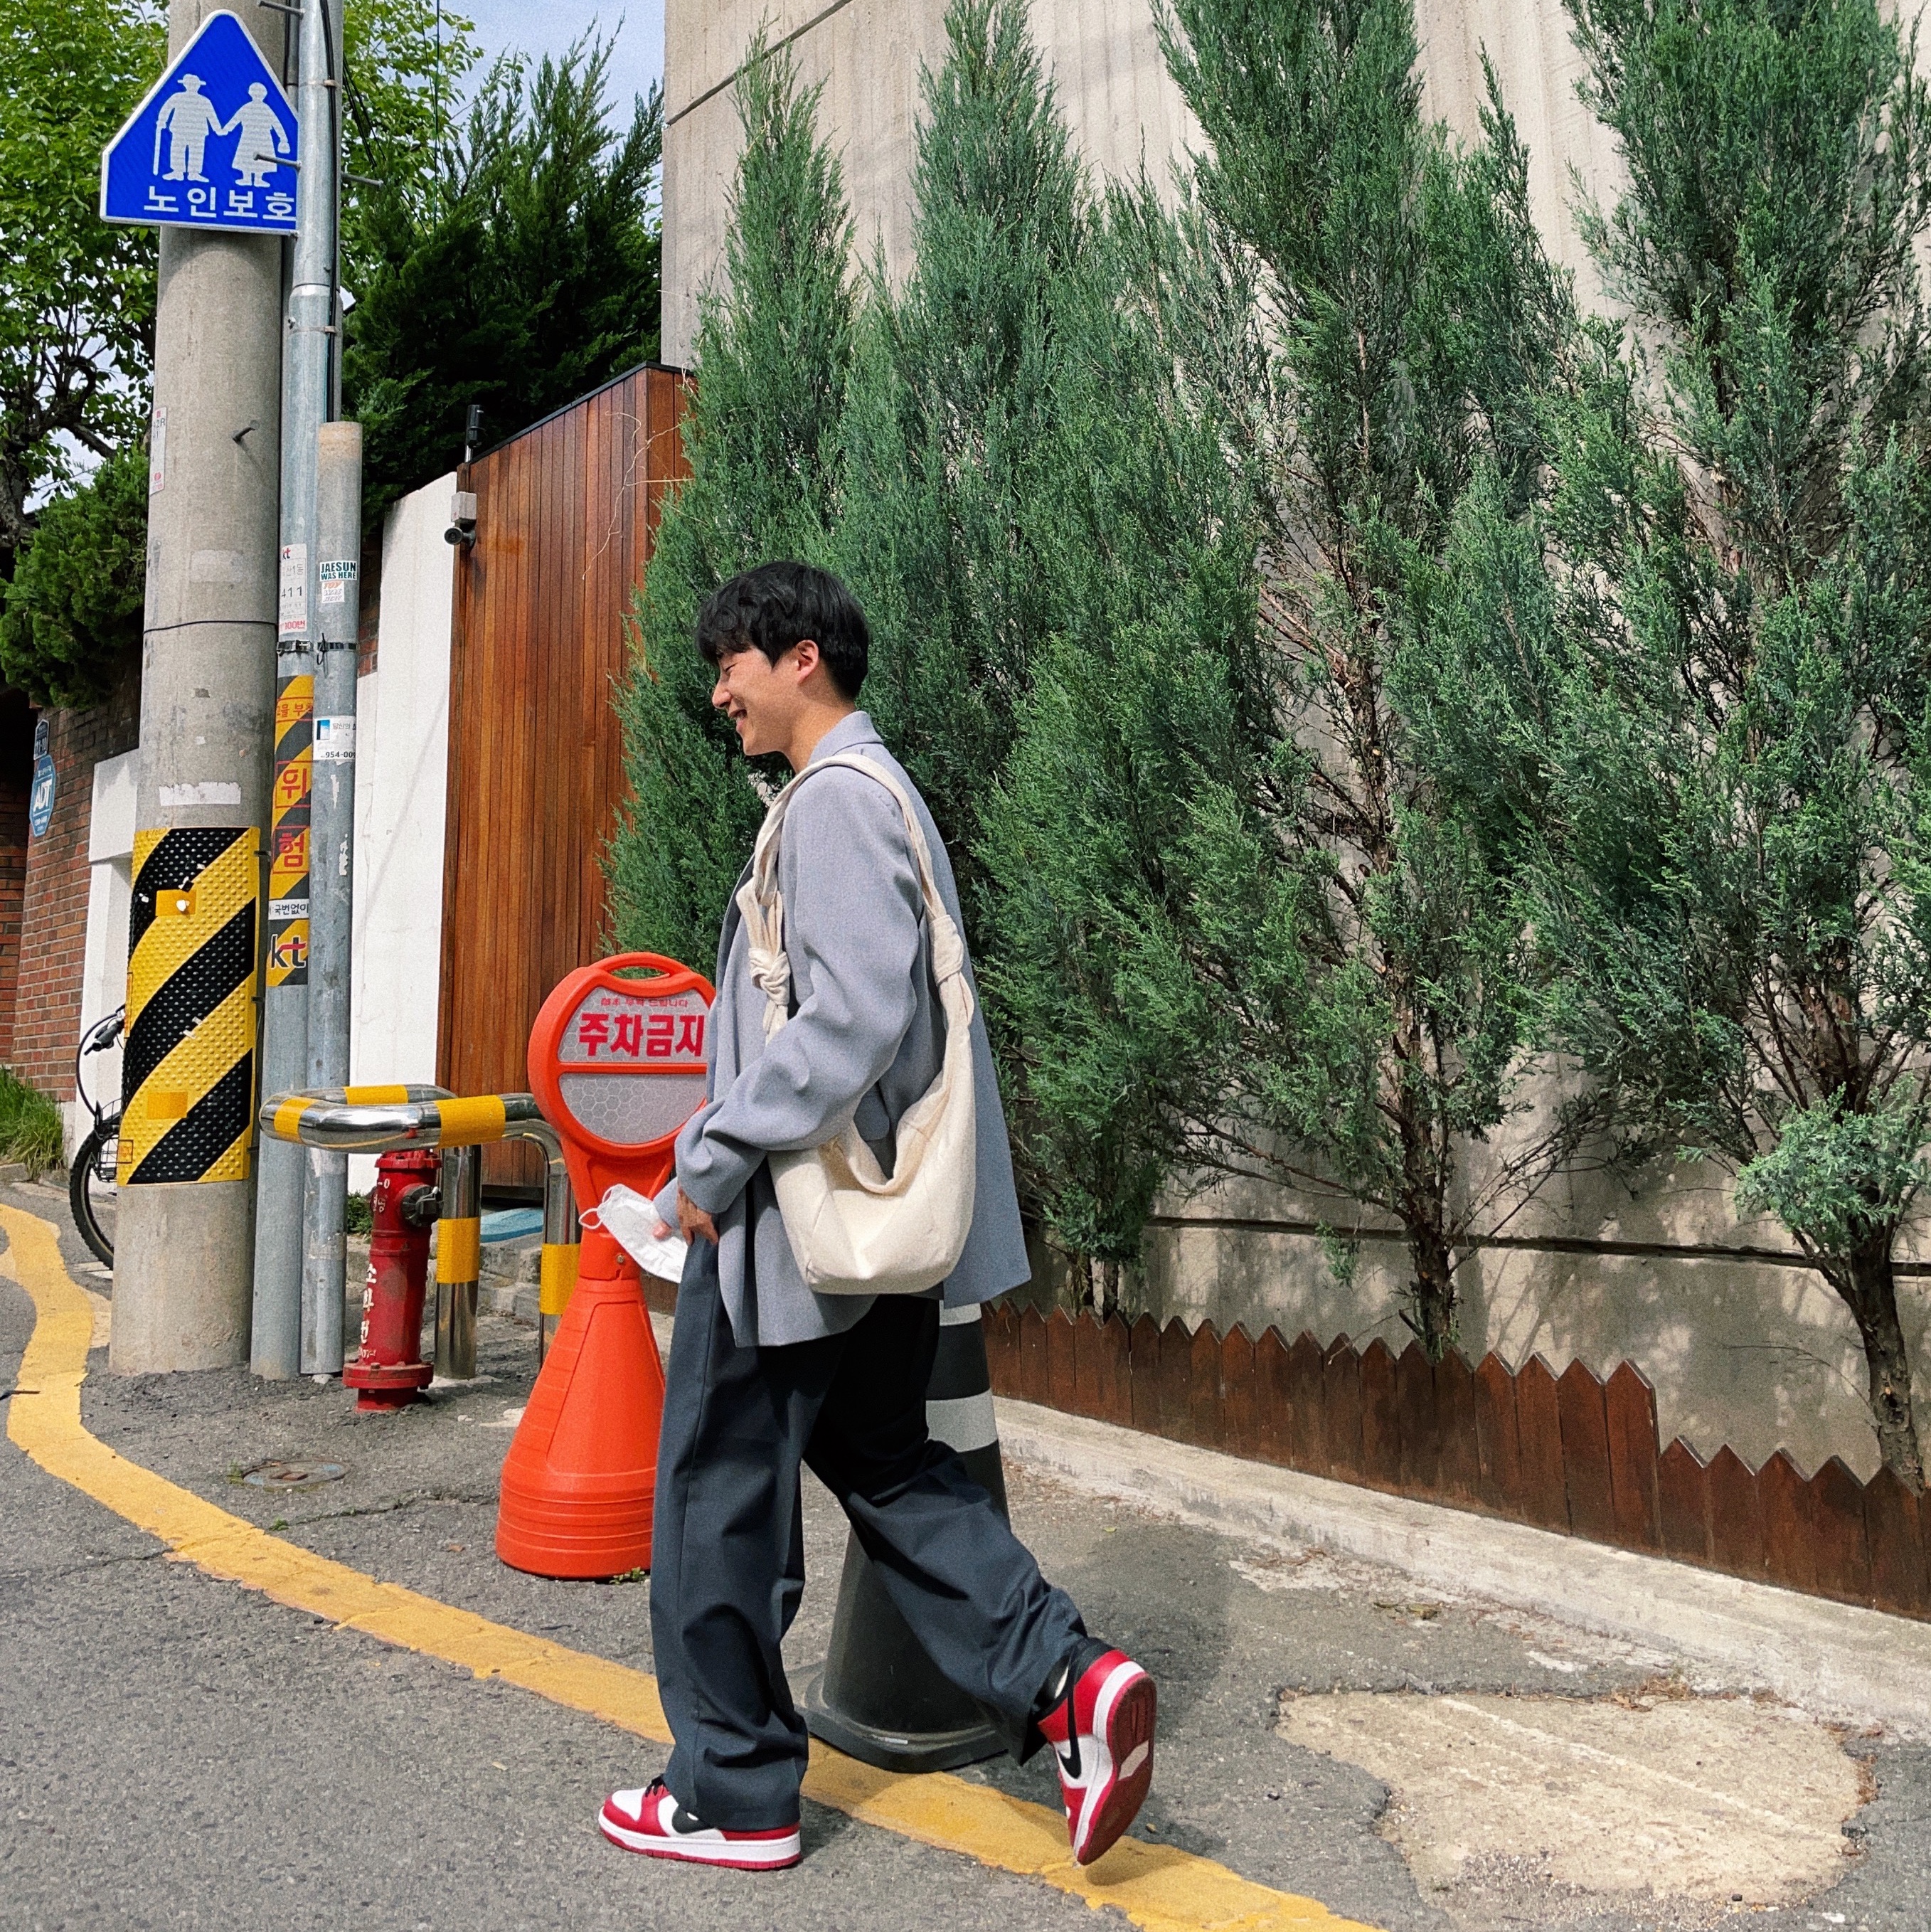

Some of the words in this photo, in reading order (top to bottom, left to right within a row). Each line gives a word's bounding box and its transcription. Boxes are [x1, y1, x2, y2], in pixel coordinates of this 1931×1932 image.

[144, 185, 297, 222] 노인보호
[321, 561, 356, 573] JAESUN
[321, 572, 336, 580] WAS
[338, 571, 356, 580] HERE
[270, 933, 307, 970] kt
[578, 1012, 705, 1058] 주차금지
